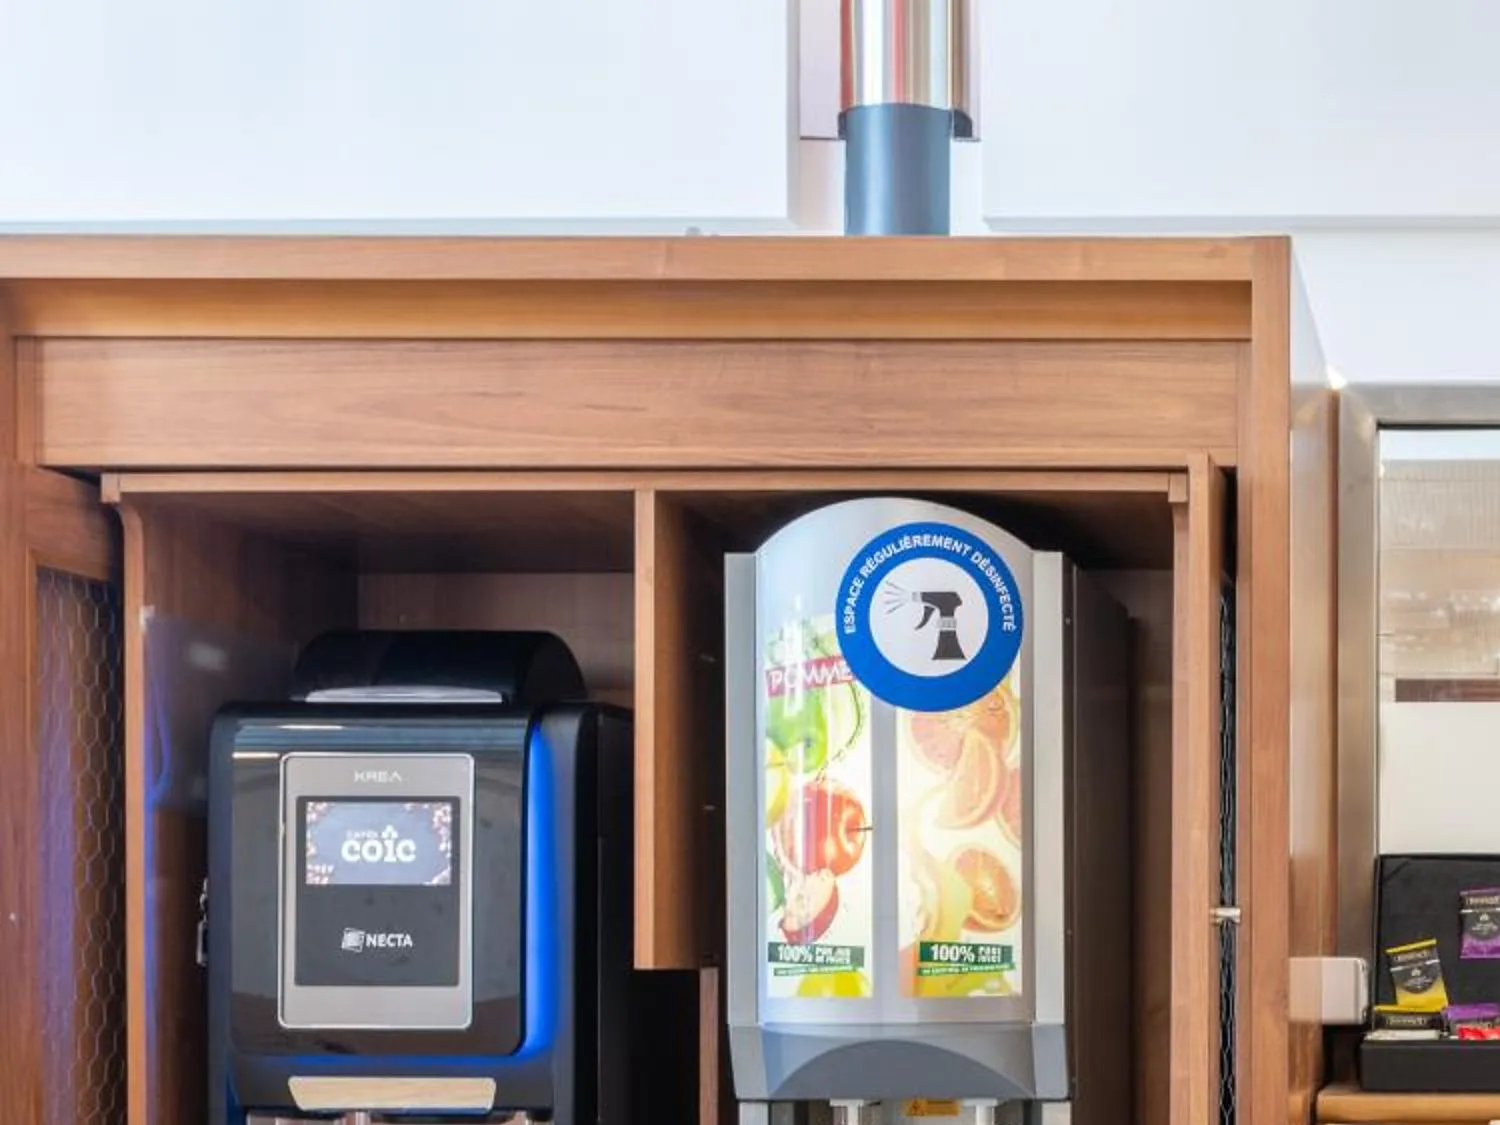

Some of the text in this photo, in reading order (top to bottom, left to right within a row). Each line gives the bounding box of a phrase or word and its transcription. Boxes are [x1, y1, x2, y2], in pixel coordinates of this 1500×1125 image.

[844, 576, 865, 635] ESPACE
[366, 933, 413, 947] NECTA
[778, 944, 813, 962] 100%
[930, 943, 976, 962] 100%
